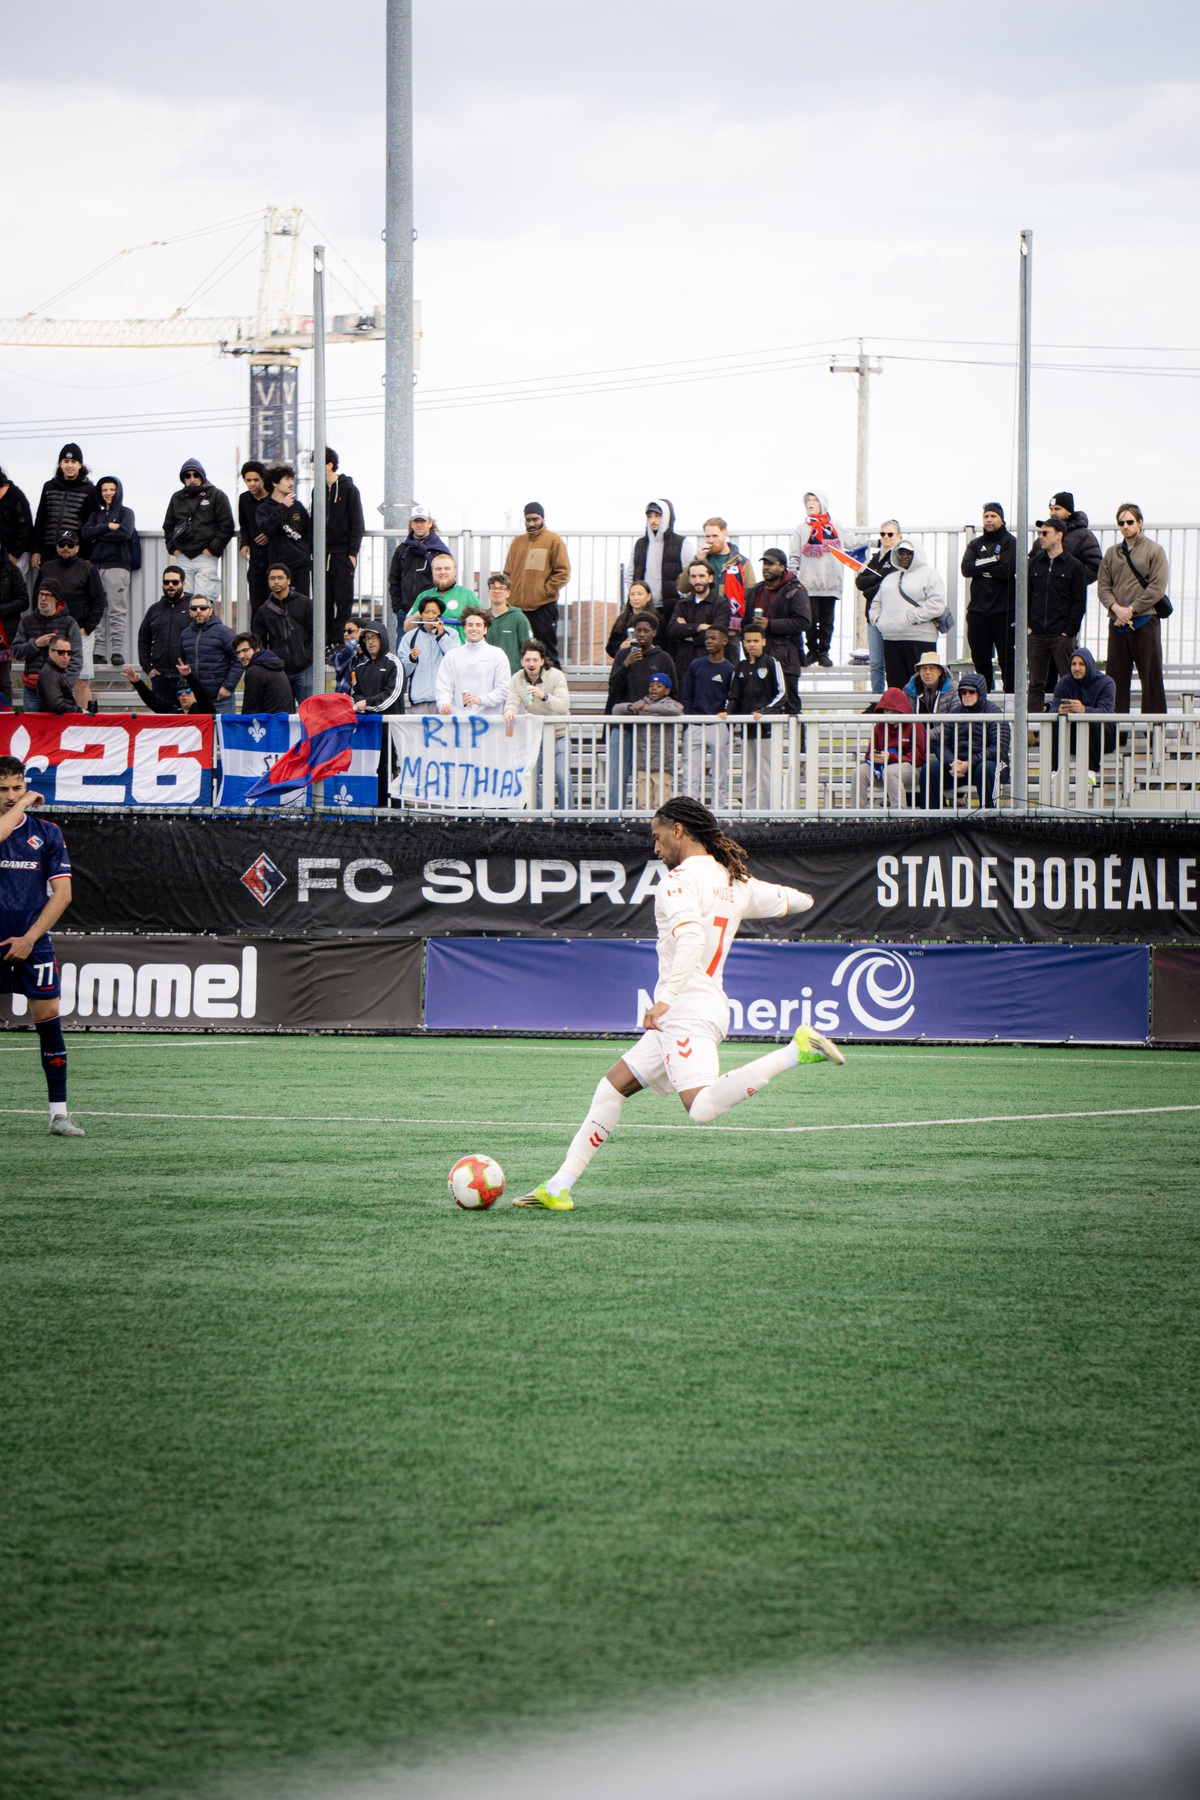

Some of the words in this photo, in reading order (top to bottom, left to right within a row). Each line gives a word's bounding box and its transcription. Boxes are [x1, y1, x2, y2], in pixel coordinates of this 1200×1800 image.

[421, 715, 490, 749] RIP
[55, 726, 203, 804] 26
[399, 756, 526, 800] MATTHIAS
[297, 858, 394, 904] FC
[421, 858, 670, 905] SUPRA
[876, 855, 999, 908] STADE
[1012, 854, 1198, 911] BORÉALE
[705, 916, 729, 977] 7
[33, 961, 54, 987] 77
[636, 986, 840, 1031] Neris
